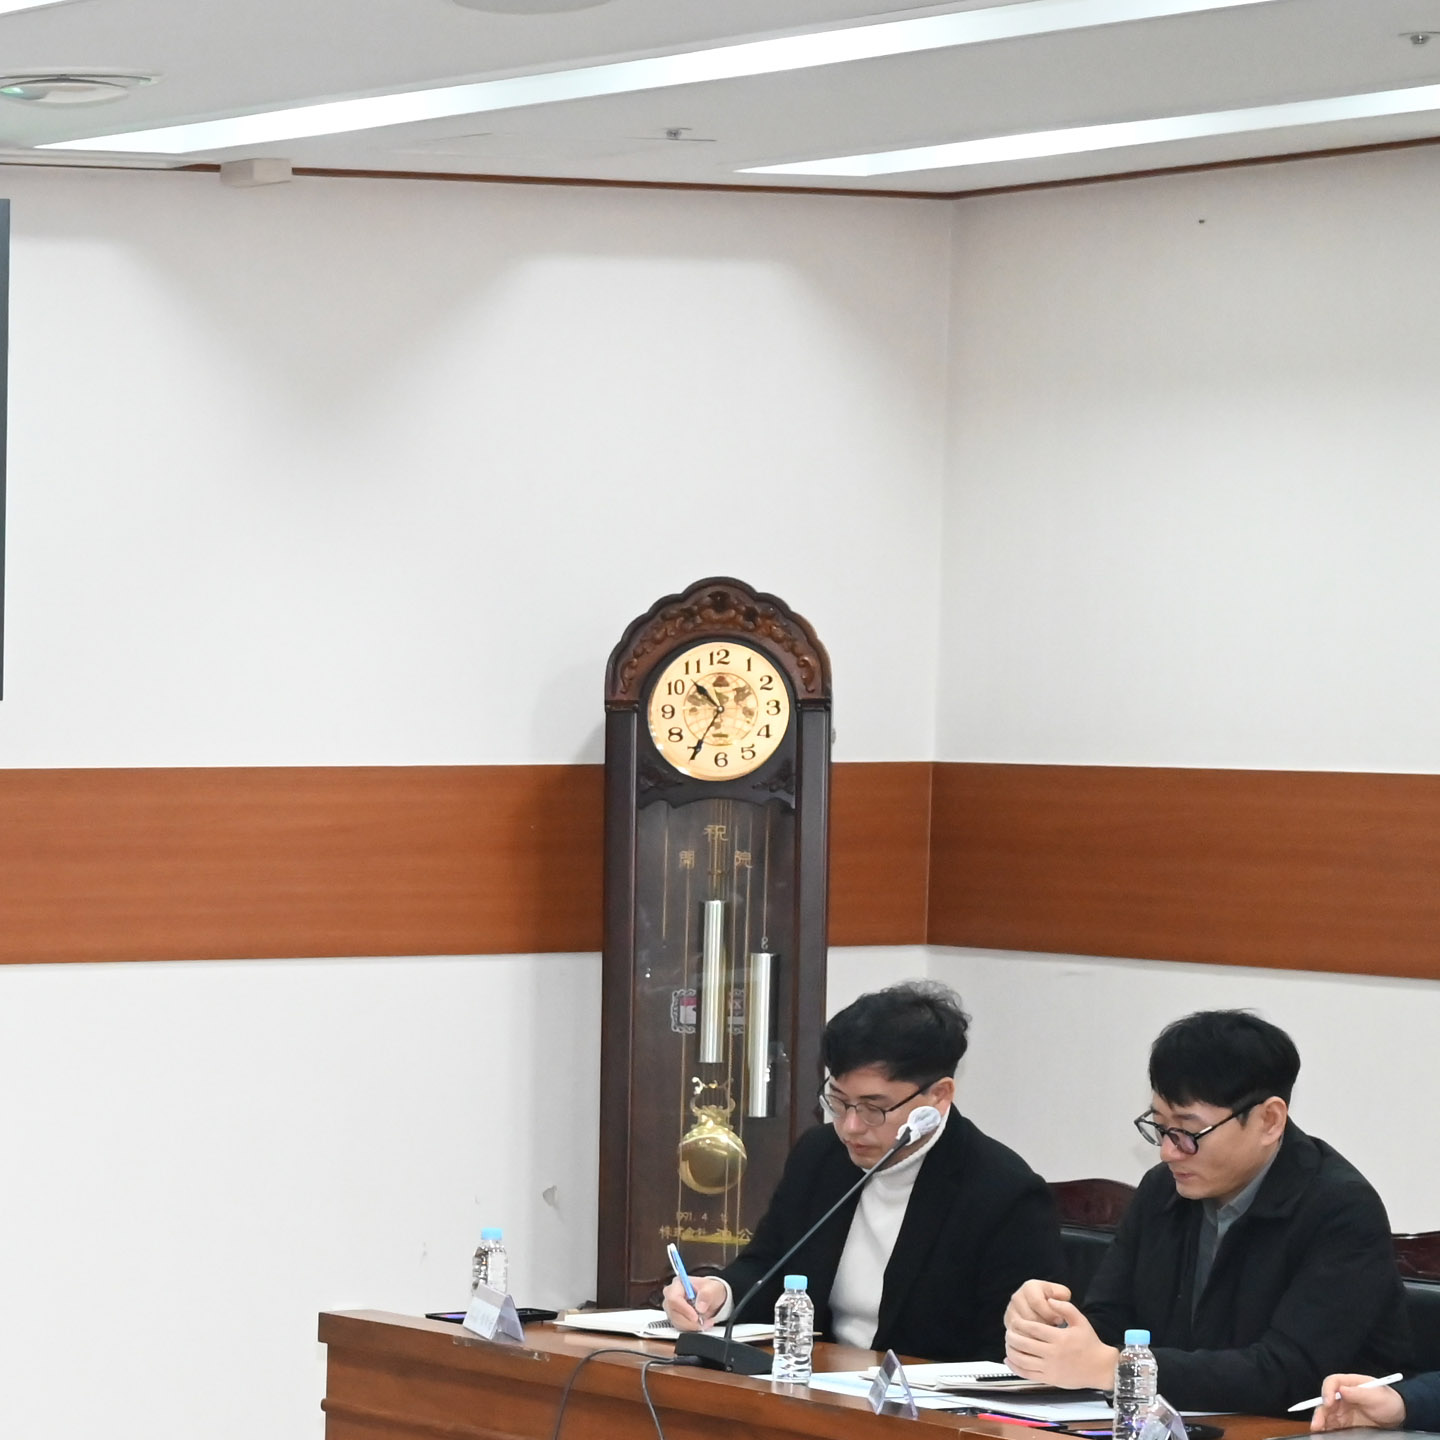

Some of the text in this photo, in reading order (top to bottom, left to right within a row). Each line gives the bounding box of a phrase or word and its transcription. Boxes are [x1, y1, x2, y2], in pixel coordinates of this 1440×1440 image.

[708, 648, 731, 666] 12
[746, 657, 753, 672] 1
[684, 658, 701, 675] 11
[666, 679, 685, 696] 10
[759, 675, 774, 691] 2
[661, 704, 676, 719] 9
[766, 699, 781, 716] 3
[667, 727, 684, 743] 8
[756, 724, 772, 739] 4
[714, 752, 729, 768] 6
[740, 744, 756, 760] 5
